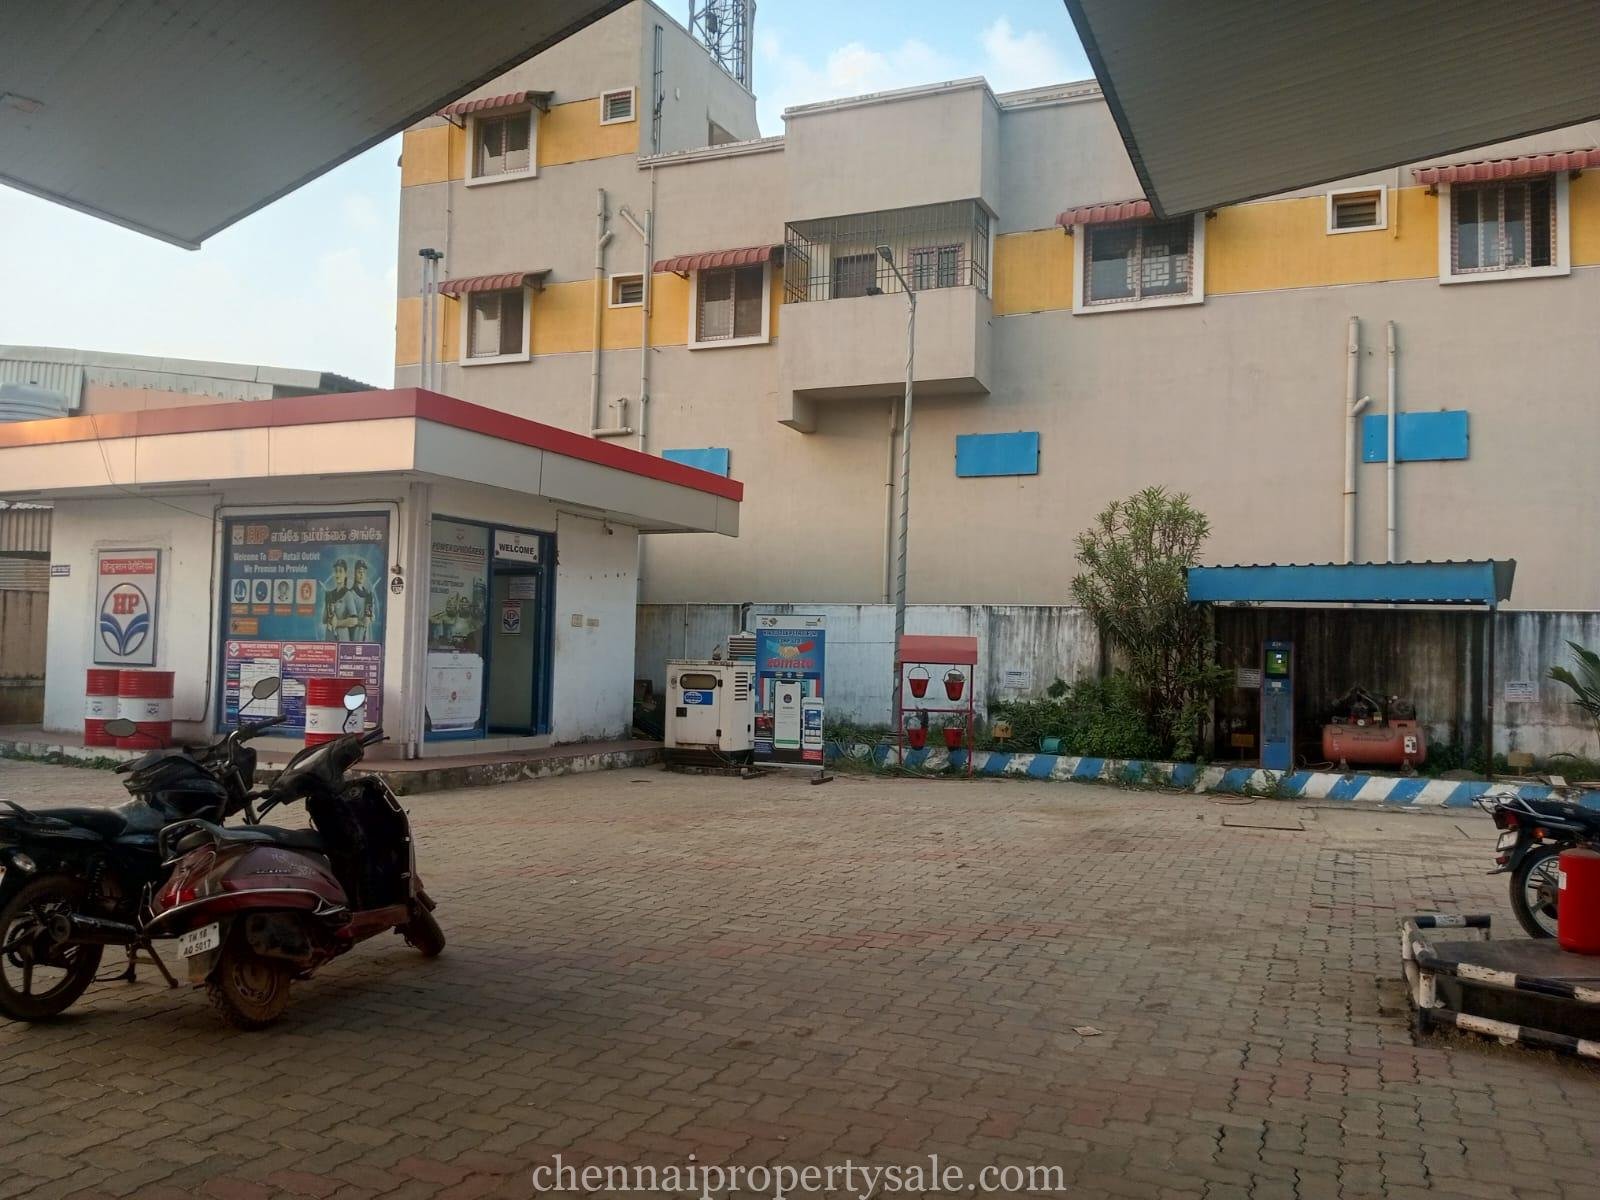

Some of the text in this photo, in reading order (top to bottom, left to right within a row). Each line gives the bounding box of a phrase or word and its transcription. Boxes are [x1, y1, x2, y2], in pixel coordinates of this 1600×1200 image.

[499, 543, 535, 555] WELCOME
[233, 552, 259, 561] Welcome
[112, 593, 140, 614] HP
